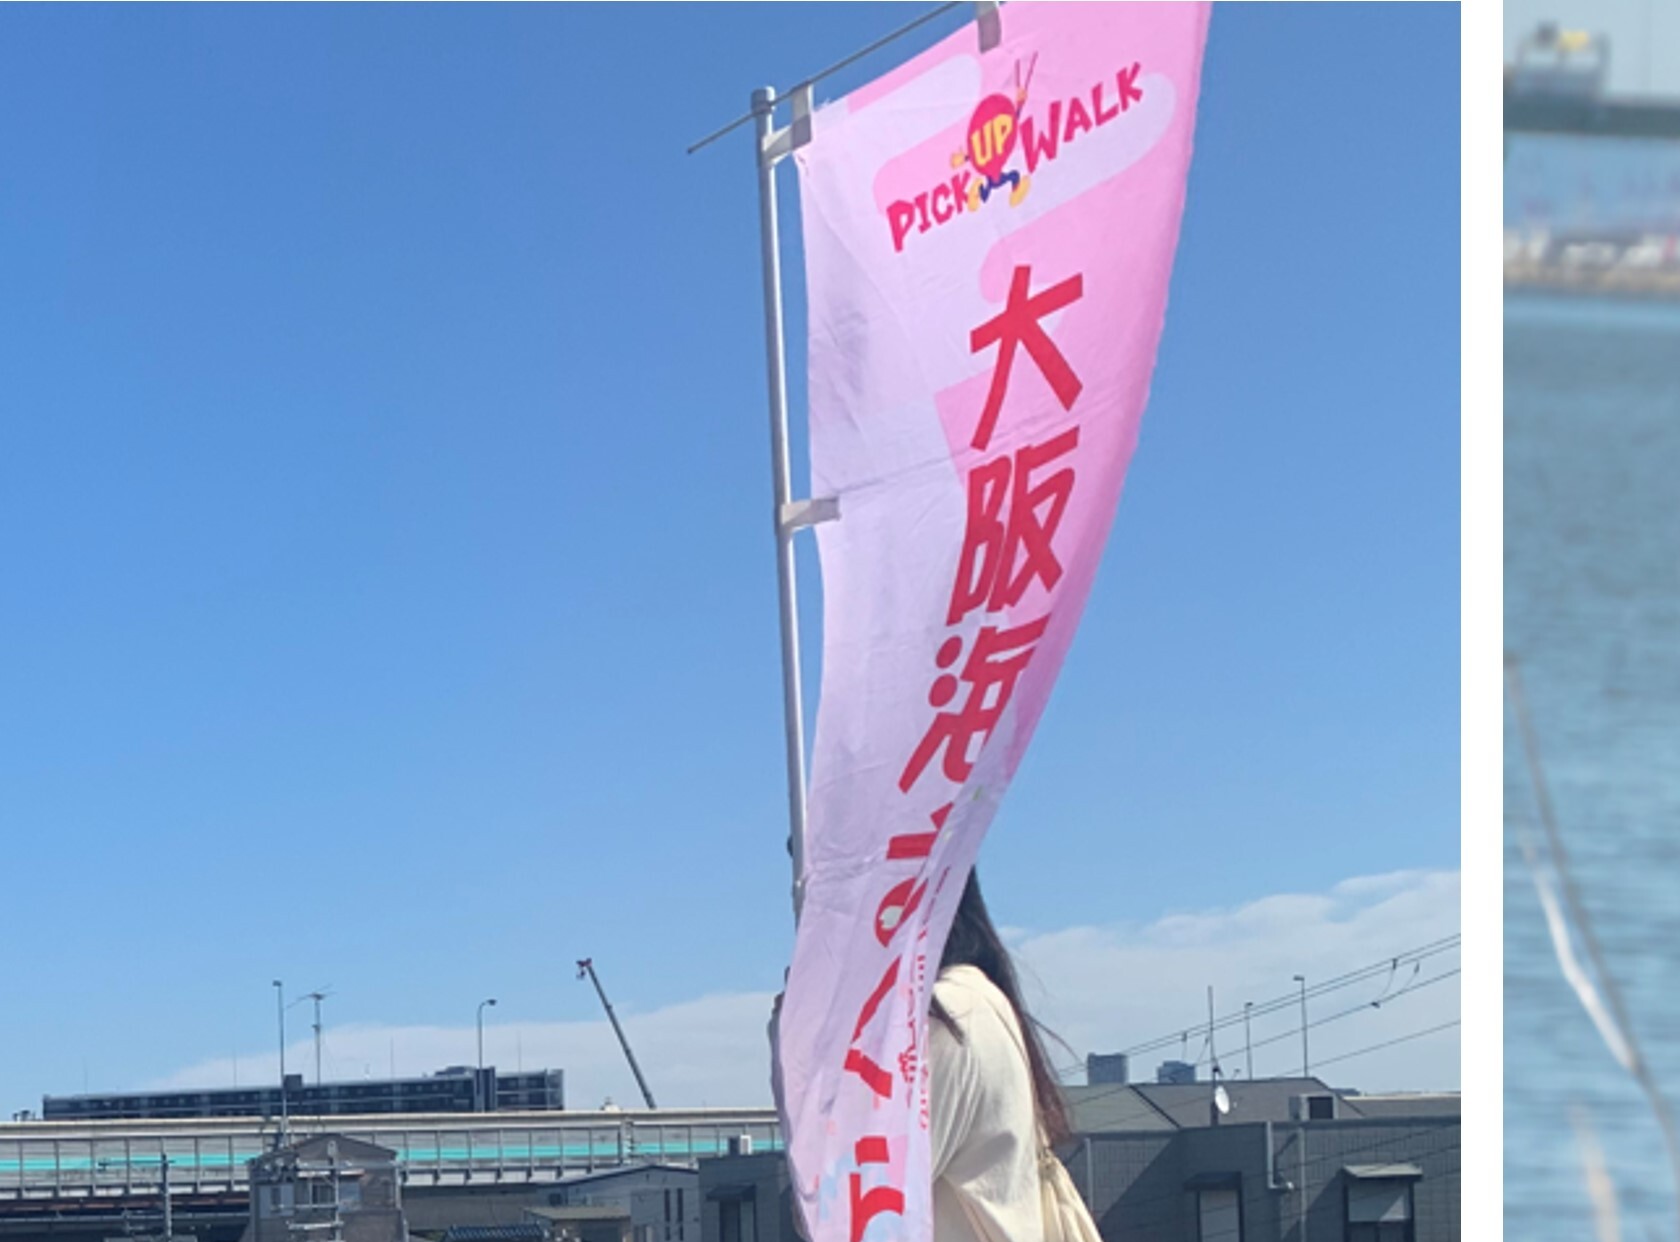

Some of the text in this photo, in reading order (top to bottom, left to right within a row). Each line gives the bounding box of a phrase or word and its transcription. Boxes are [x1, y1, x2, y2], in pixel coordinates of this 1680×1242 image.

[886, 61, 1143, 253] PICK UP WALK
